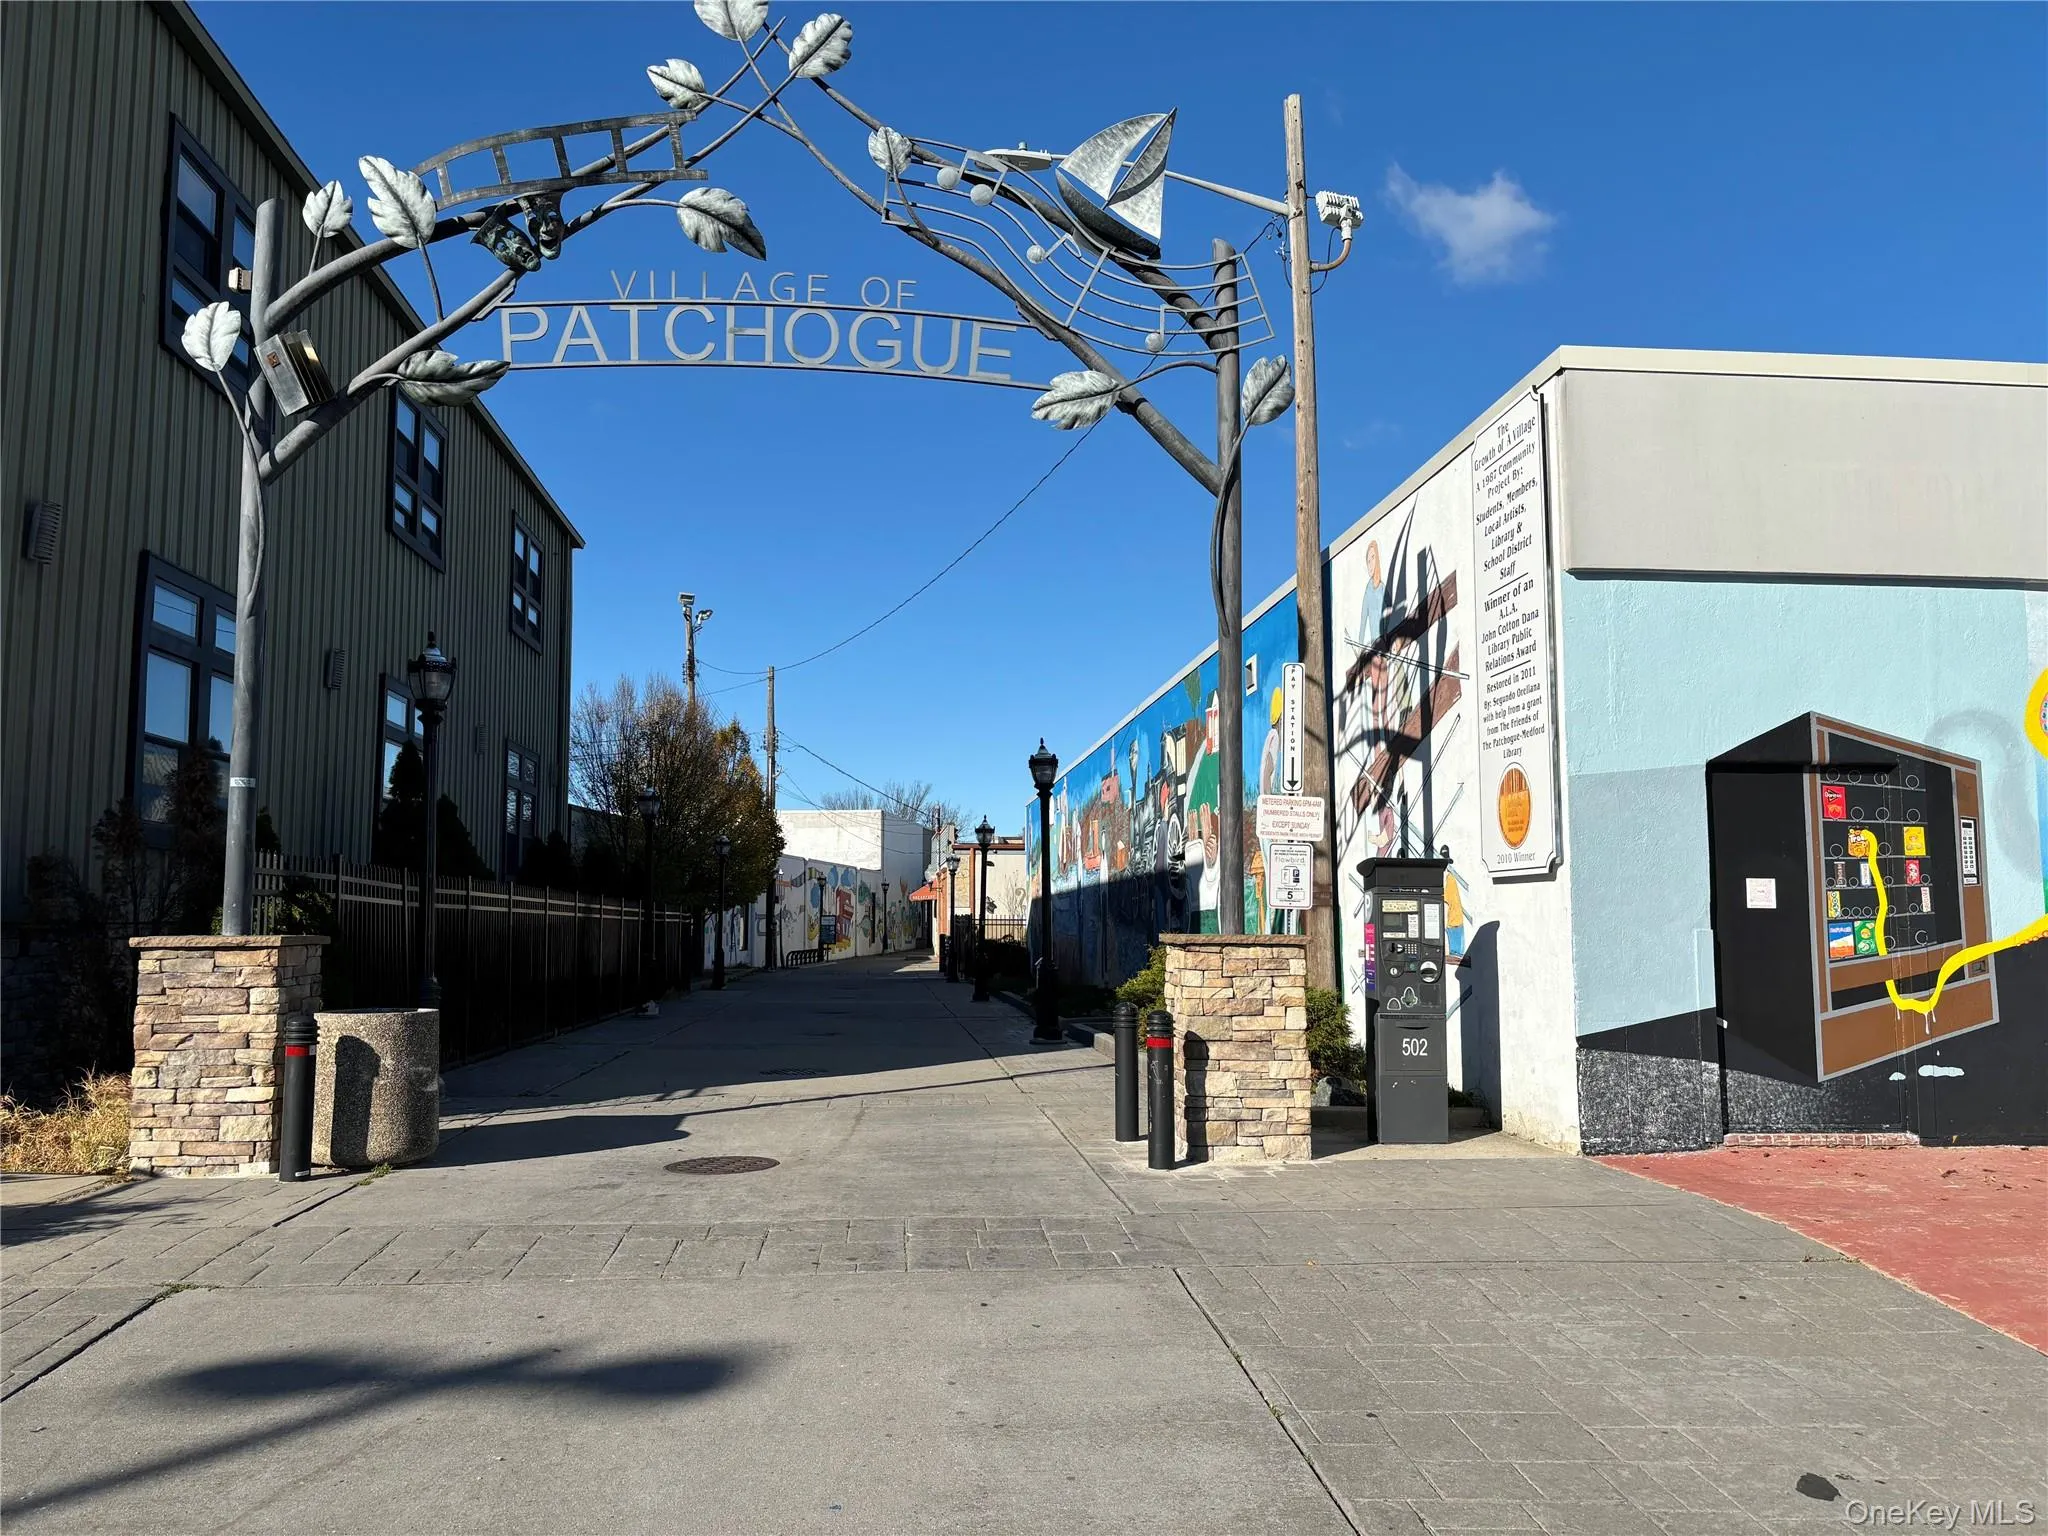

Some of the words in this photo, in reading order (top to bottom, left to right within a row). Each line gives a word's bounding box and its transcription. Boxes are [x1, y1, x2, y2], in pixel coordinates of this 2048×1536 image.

[610, 270, 829, 304] VILLAGE
[861, 276, 916, 309] OF
[503, 304, 1017, 381] PATCHOGUE
[1474, 446, 1496, 472] Growth
[1498, 438, 1504, 454] of
[1507, 433, 1512, 446] A
[1512, 416, 1536, 441] Village
[1498, 423, 1508, 438] The
[1476, 482, 1480, 494] A
[1482, 469, 1496, 488] 1987
[1498, 441, 1536, 476] Community
[1488, 474, 1510, 499] Project
[1512, 466, 1523, 481] By:
[1476, 500, 1505, 526] Students,
[1506, 477, 1538, 504] Members,
[1484, 516, 1502, 537] Local
[1502, 503, 1527, 526] Artists,
[1492, 528, 1514, 550] Library
[1516, 521, 1522, 534] &
[1484, 549, 1505, 572] School
[1506, 533, 1532, 558] District
[1500, 560, 1516, 580] Staff
[1484, 591, 1511, 612] Winner
[1512, 582, 1522, 598] of
[1523, 579, 1534, 592] an
[1499, 602, 1518, 620] A.L.A.
[1481, 630, 1496, 644] John
[1498, 618, 1520, 636] Cotton
[1522, 609, 1539, 624] Dana
[1485, 652, 1515, 672] Relations
[1516, 639, 1536, 659] Award
[1488, 638, 1510, 656] Library
[1512, 627, 1532, 645] Public
[1486, 674, 1512, 694] Restored
[1512, 673, 1520, 684] in
[1520, 666, 1536, 680] 2011
[1483, 712, 1494, 723] with
[1495, 708, 1506, 720] help
[1508, 704, 1520, 715] from
[1526, 695, 1542, 711] grant
[1492, 691, 1516, 706] Segundo
[1482, 742, 1492, 751] The
[1492, 723, 1545, 748] Patchogue-Medford
[1486, 726, 1499, 736] from
[1500, 722, 1510, 732] The
[1510, 714, 1532, 728] Friends
[1532, 710, 1540, 721] of
[1503, 746, 1522, 758] Library
[1272, 820, 1290, 828] EXCEPT
[1497, 852, 1512, 864] 2010
[1513, 852, 1536, 862] Winner
[1287, 890, 1294, 900] 5
[1402, 1038, 1428, 1056] 502
